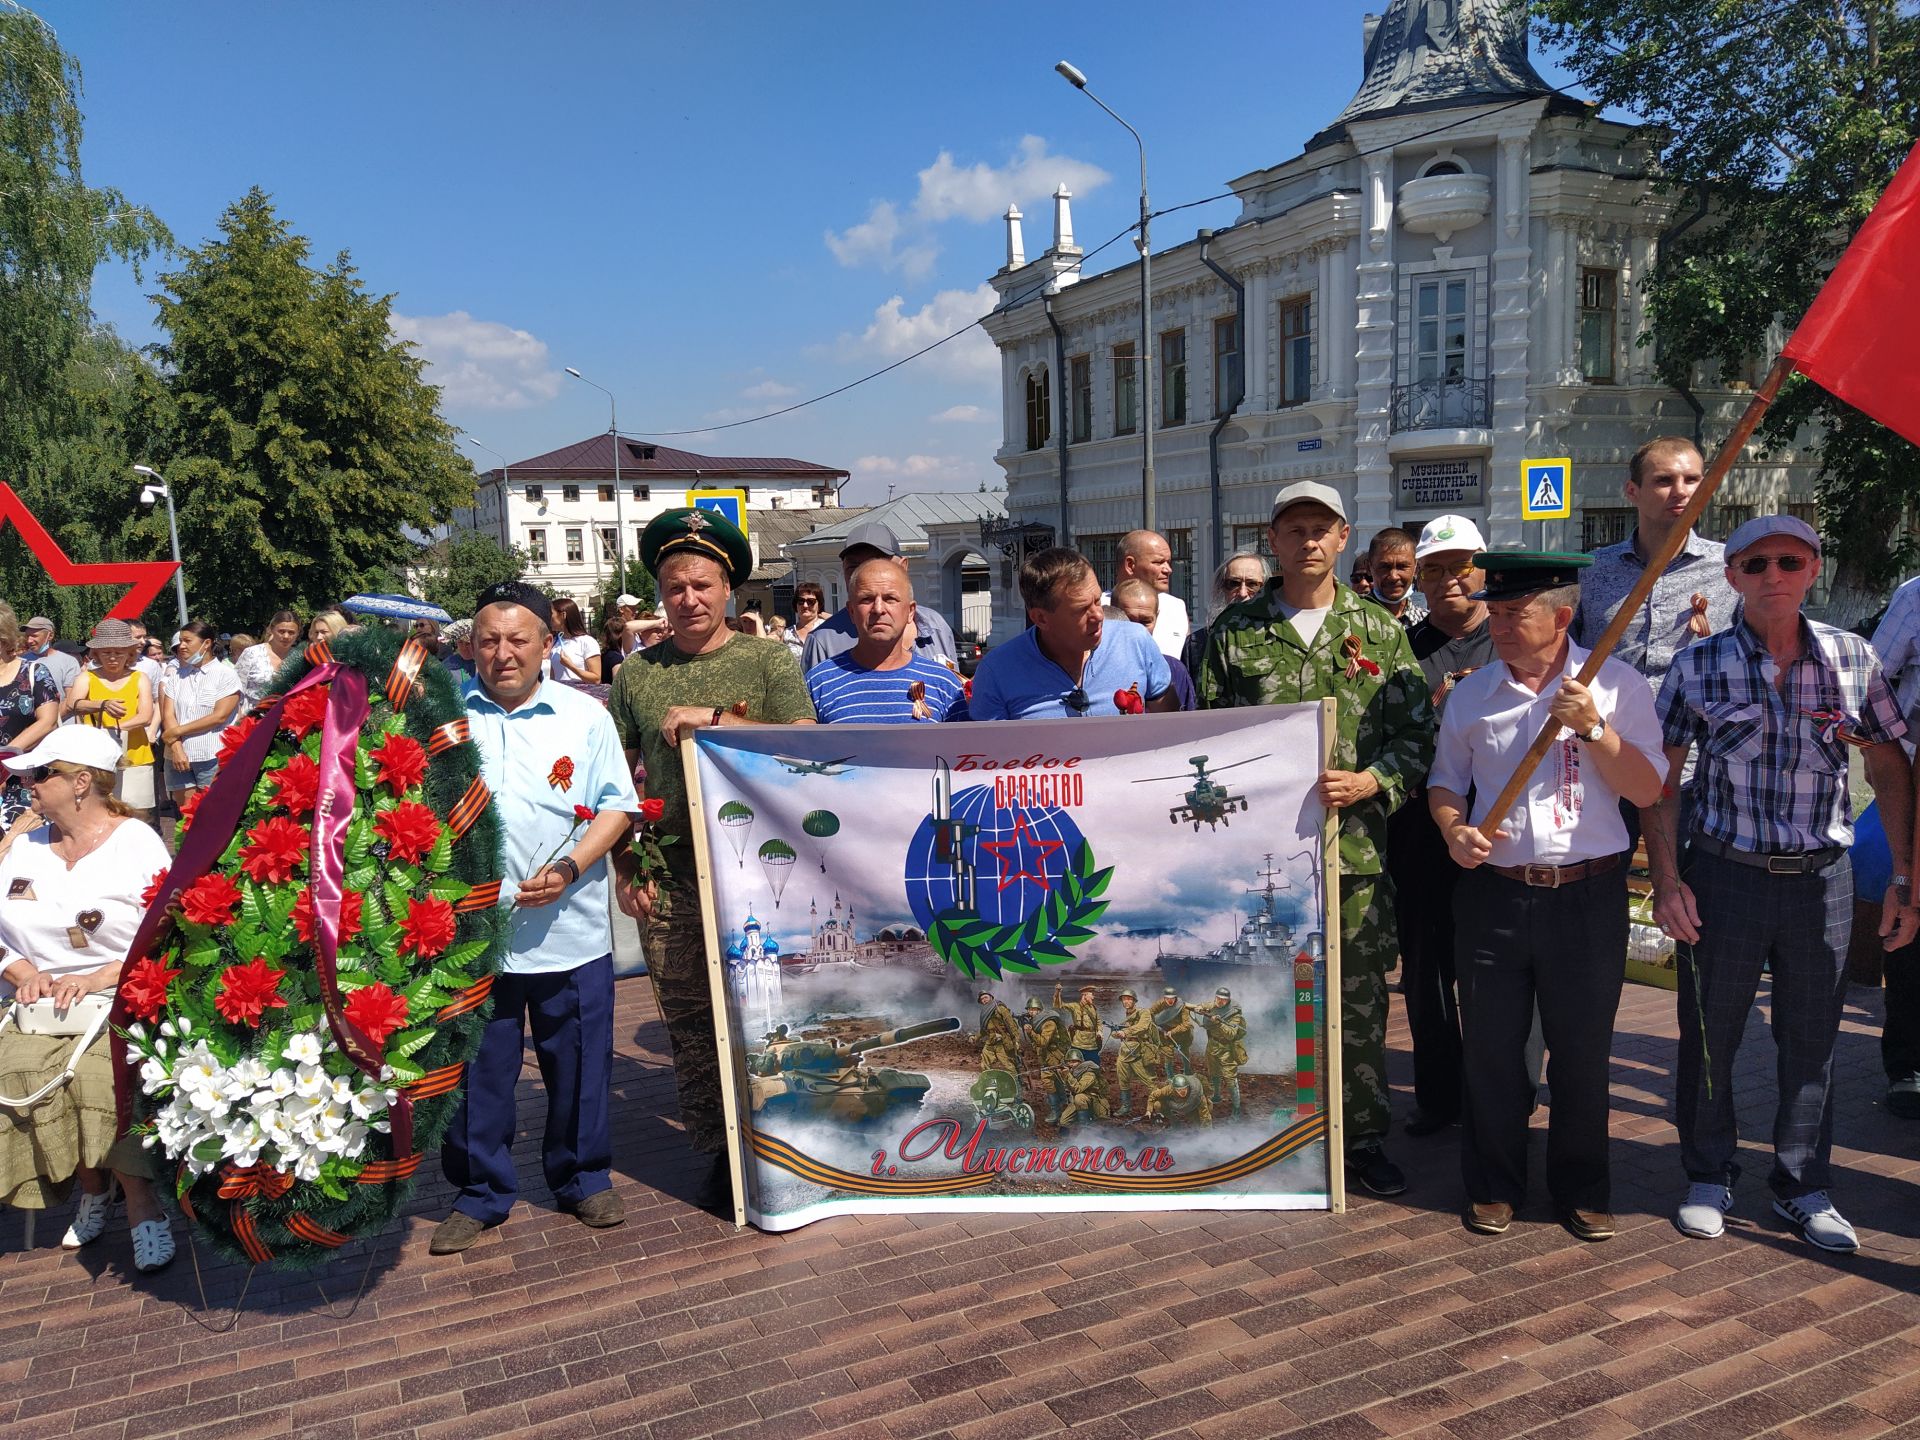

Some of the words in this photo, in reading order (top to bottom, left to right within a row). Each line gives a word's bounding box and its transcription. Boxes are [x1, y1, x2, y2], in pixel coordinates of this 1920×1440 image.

[1410, 461, 1469, 477] МУЗЕЙНЫЙ
[1402, 473, 1478, 490] СУВЕНИРНЫЙ
[1415, 489, 1464, 503] САЛОНЪ
[953, 754, 1082, 772] Боевое
[994, 773, 1083, 809] БРАТСТВО
[1299, 992, 1311, 1002] 28
[870, 1149, 898, 1175] г.
[900, 1118, 1176, 1174] Чистополь
